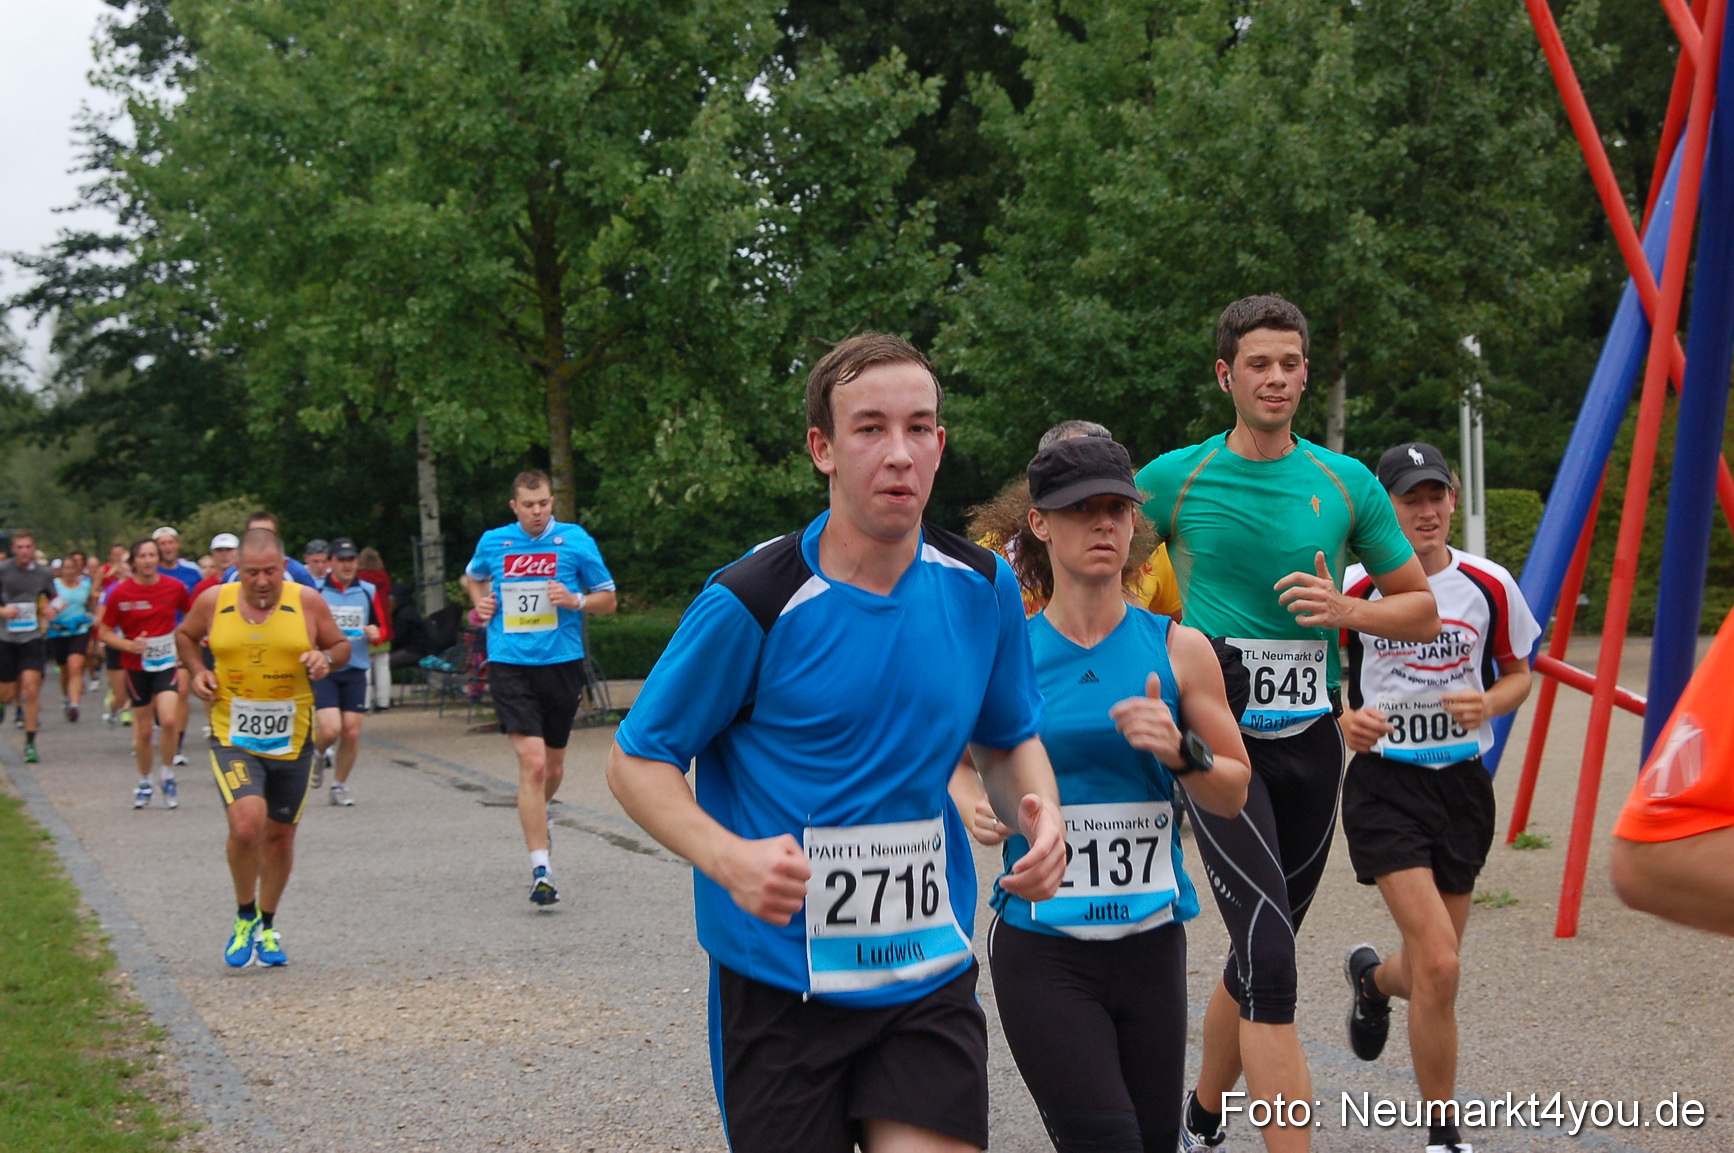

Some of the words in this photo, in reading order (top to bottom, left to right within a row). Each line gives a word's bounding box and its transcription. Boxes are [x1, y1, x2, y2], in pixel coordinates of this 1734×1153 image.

[504, 554, 556, 577] Lete
[518, 595, 539, 613] 37
[1262, 650, 1312, 661] Neumarkt
[1247, 665, 1317, 706] 643
[237, 713, 289, 736] 2890
[1413, 750, 1451, 762] Julius
[1084, 817, 1150, 831] Neumarkt
[808, 843, 866, 860] PARTL
[871, 838, 930, 858] Neumarkt
[825, 861, 939, 926] 2716
[1084, 902, 1131, 921] Jutta
[856, 938, 924, 966] Ludwig
